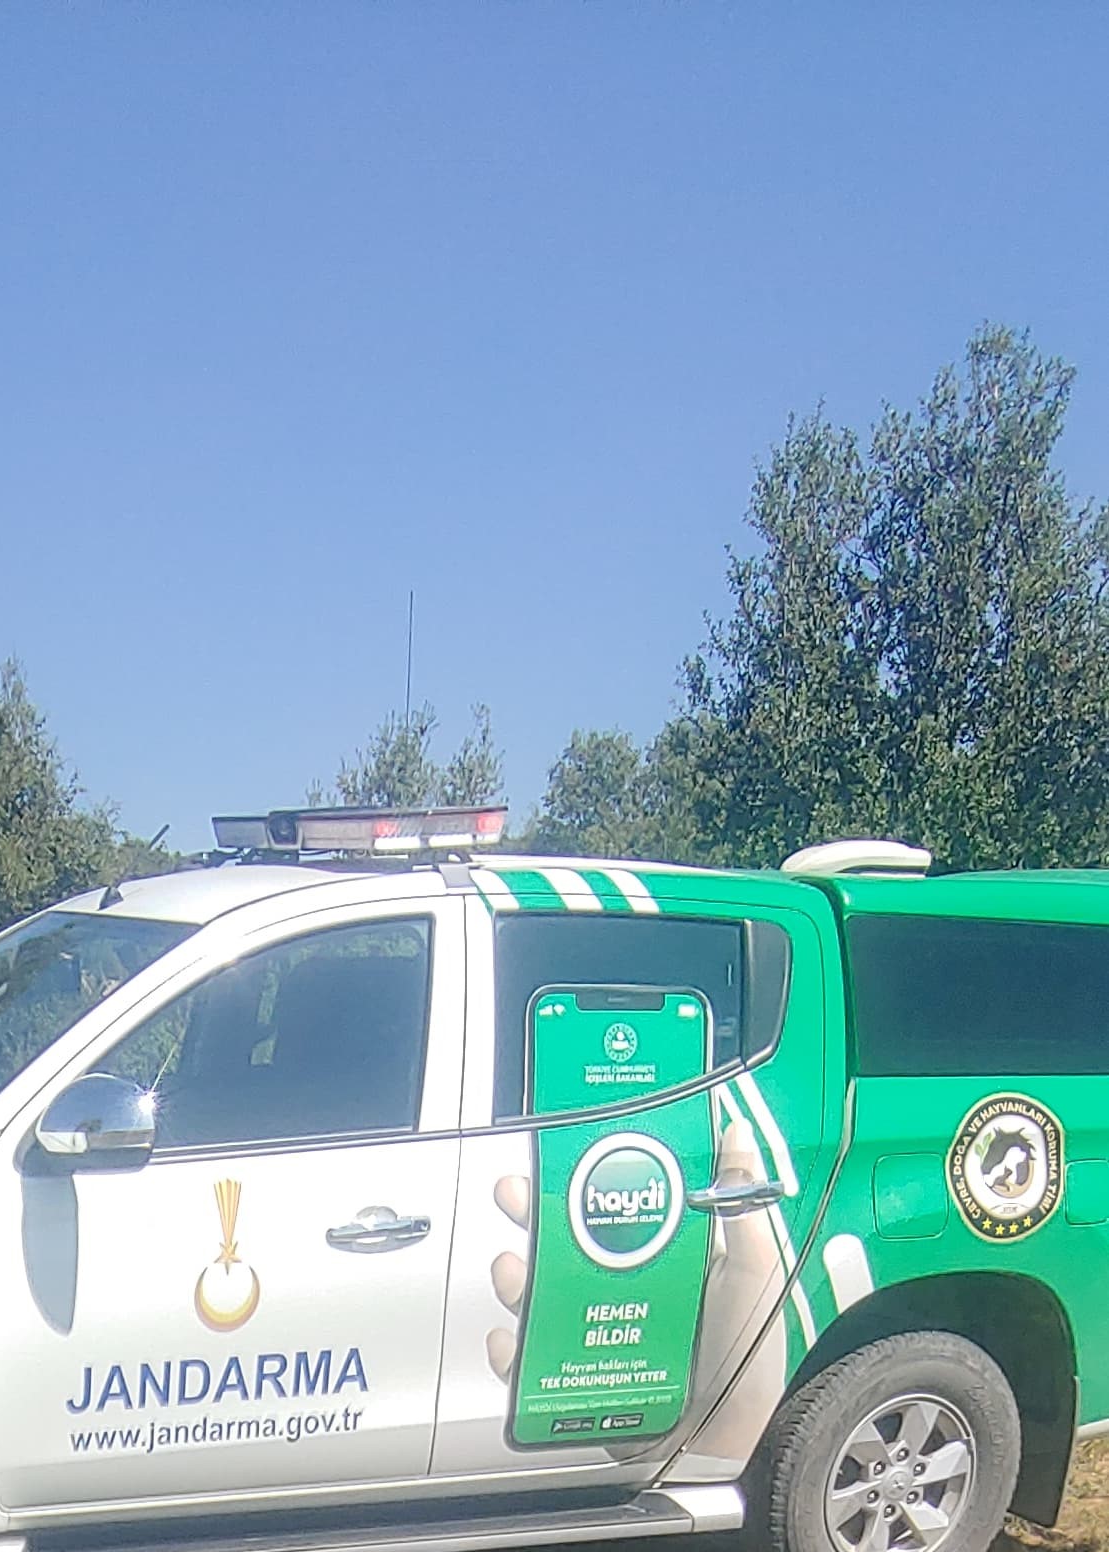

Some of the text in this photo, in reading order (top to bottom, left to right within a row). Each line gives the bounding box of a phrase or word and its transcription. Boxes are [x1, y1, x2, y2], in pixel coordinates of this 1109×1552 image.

[968, 1117, 983, 1133] VE
[980, 1101, 1046, 1126] HAYVANLARI
[1044, 1122, 1059, 1181] KORUMA
[587, 1177, 666, 1216] haydi
[586, 1302, 649, 1323] HEMEN
[585, 1324, 642, 1347] BİLDİR
[66, 1347, 369, 1415] JANDARMA
[540, 1370, 668, 1389] TEK DOKUNUŞUN YETER
[562, 1361, 597, 1375] Hayvan
[631, 1359, 648, 1371] için
[70, 1406, 363, 1454] www.jandarma.gov.tr
